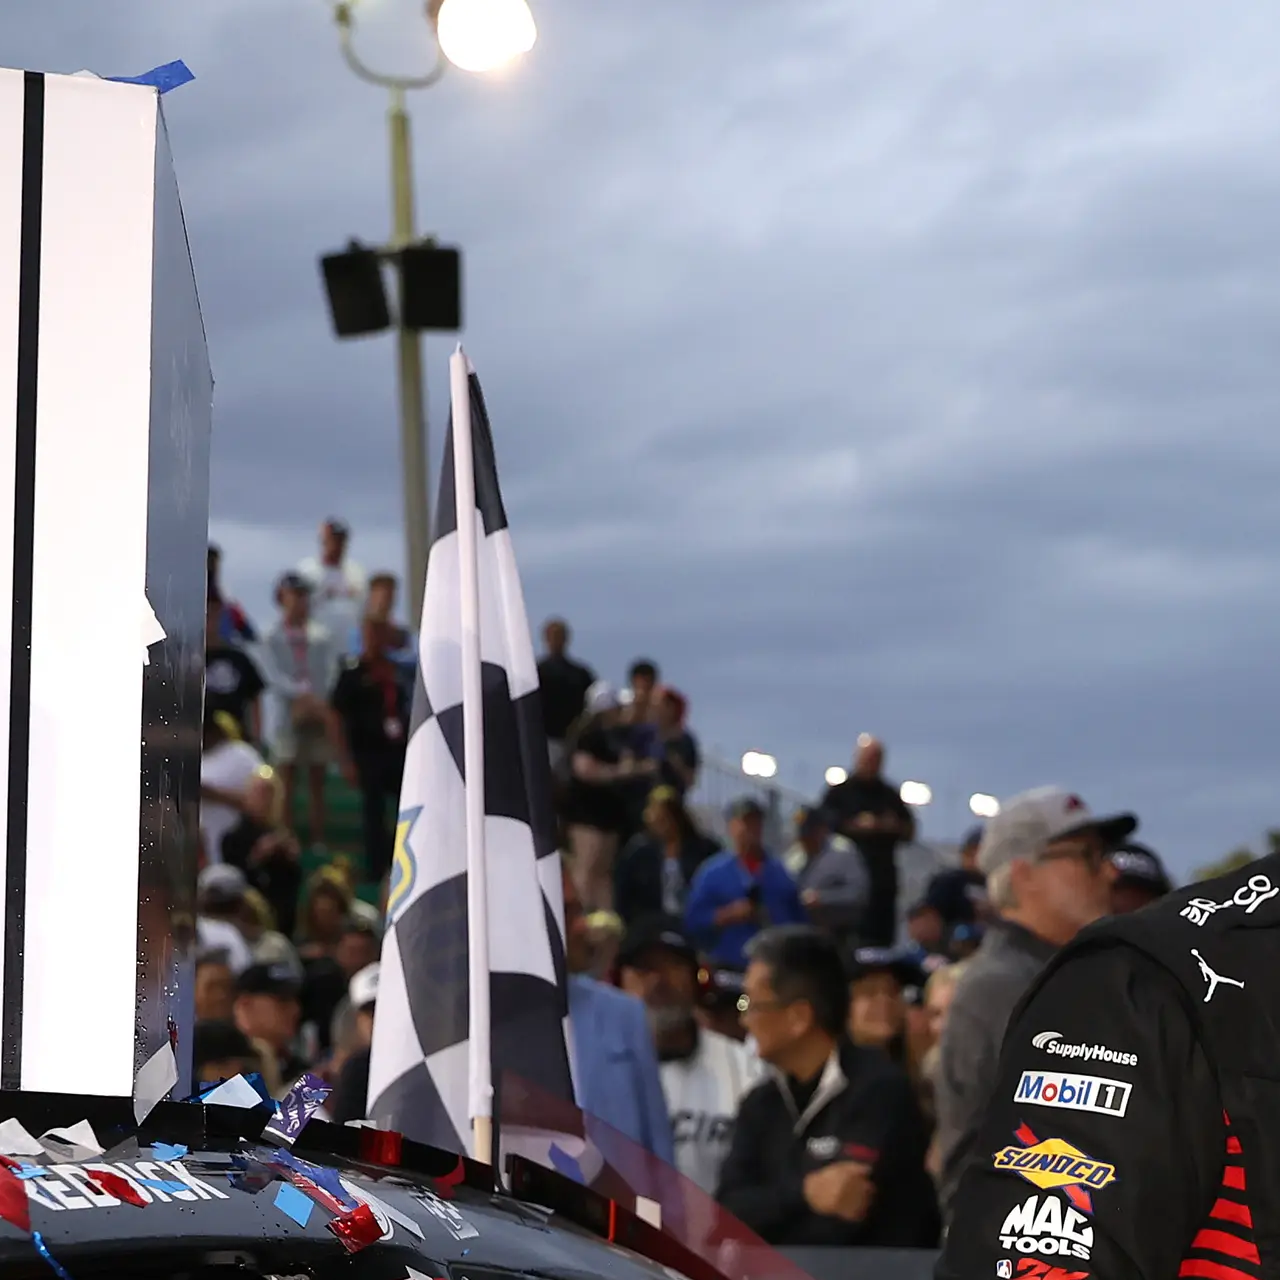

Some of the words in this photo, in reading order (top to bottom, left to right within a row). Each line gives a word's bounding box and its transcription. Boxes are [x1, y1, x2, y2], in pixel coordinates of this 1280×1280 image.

[1046, 1040, 1138, 1066] SupplyHouse
[1018, 1075, 1093, 1105] Mobil
[997, 1148, 1113, 1186] SUNOCO
[1000, 1194, 1094, 1249] MAC
[998, 1235, 1091, 1261] TOOLS
